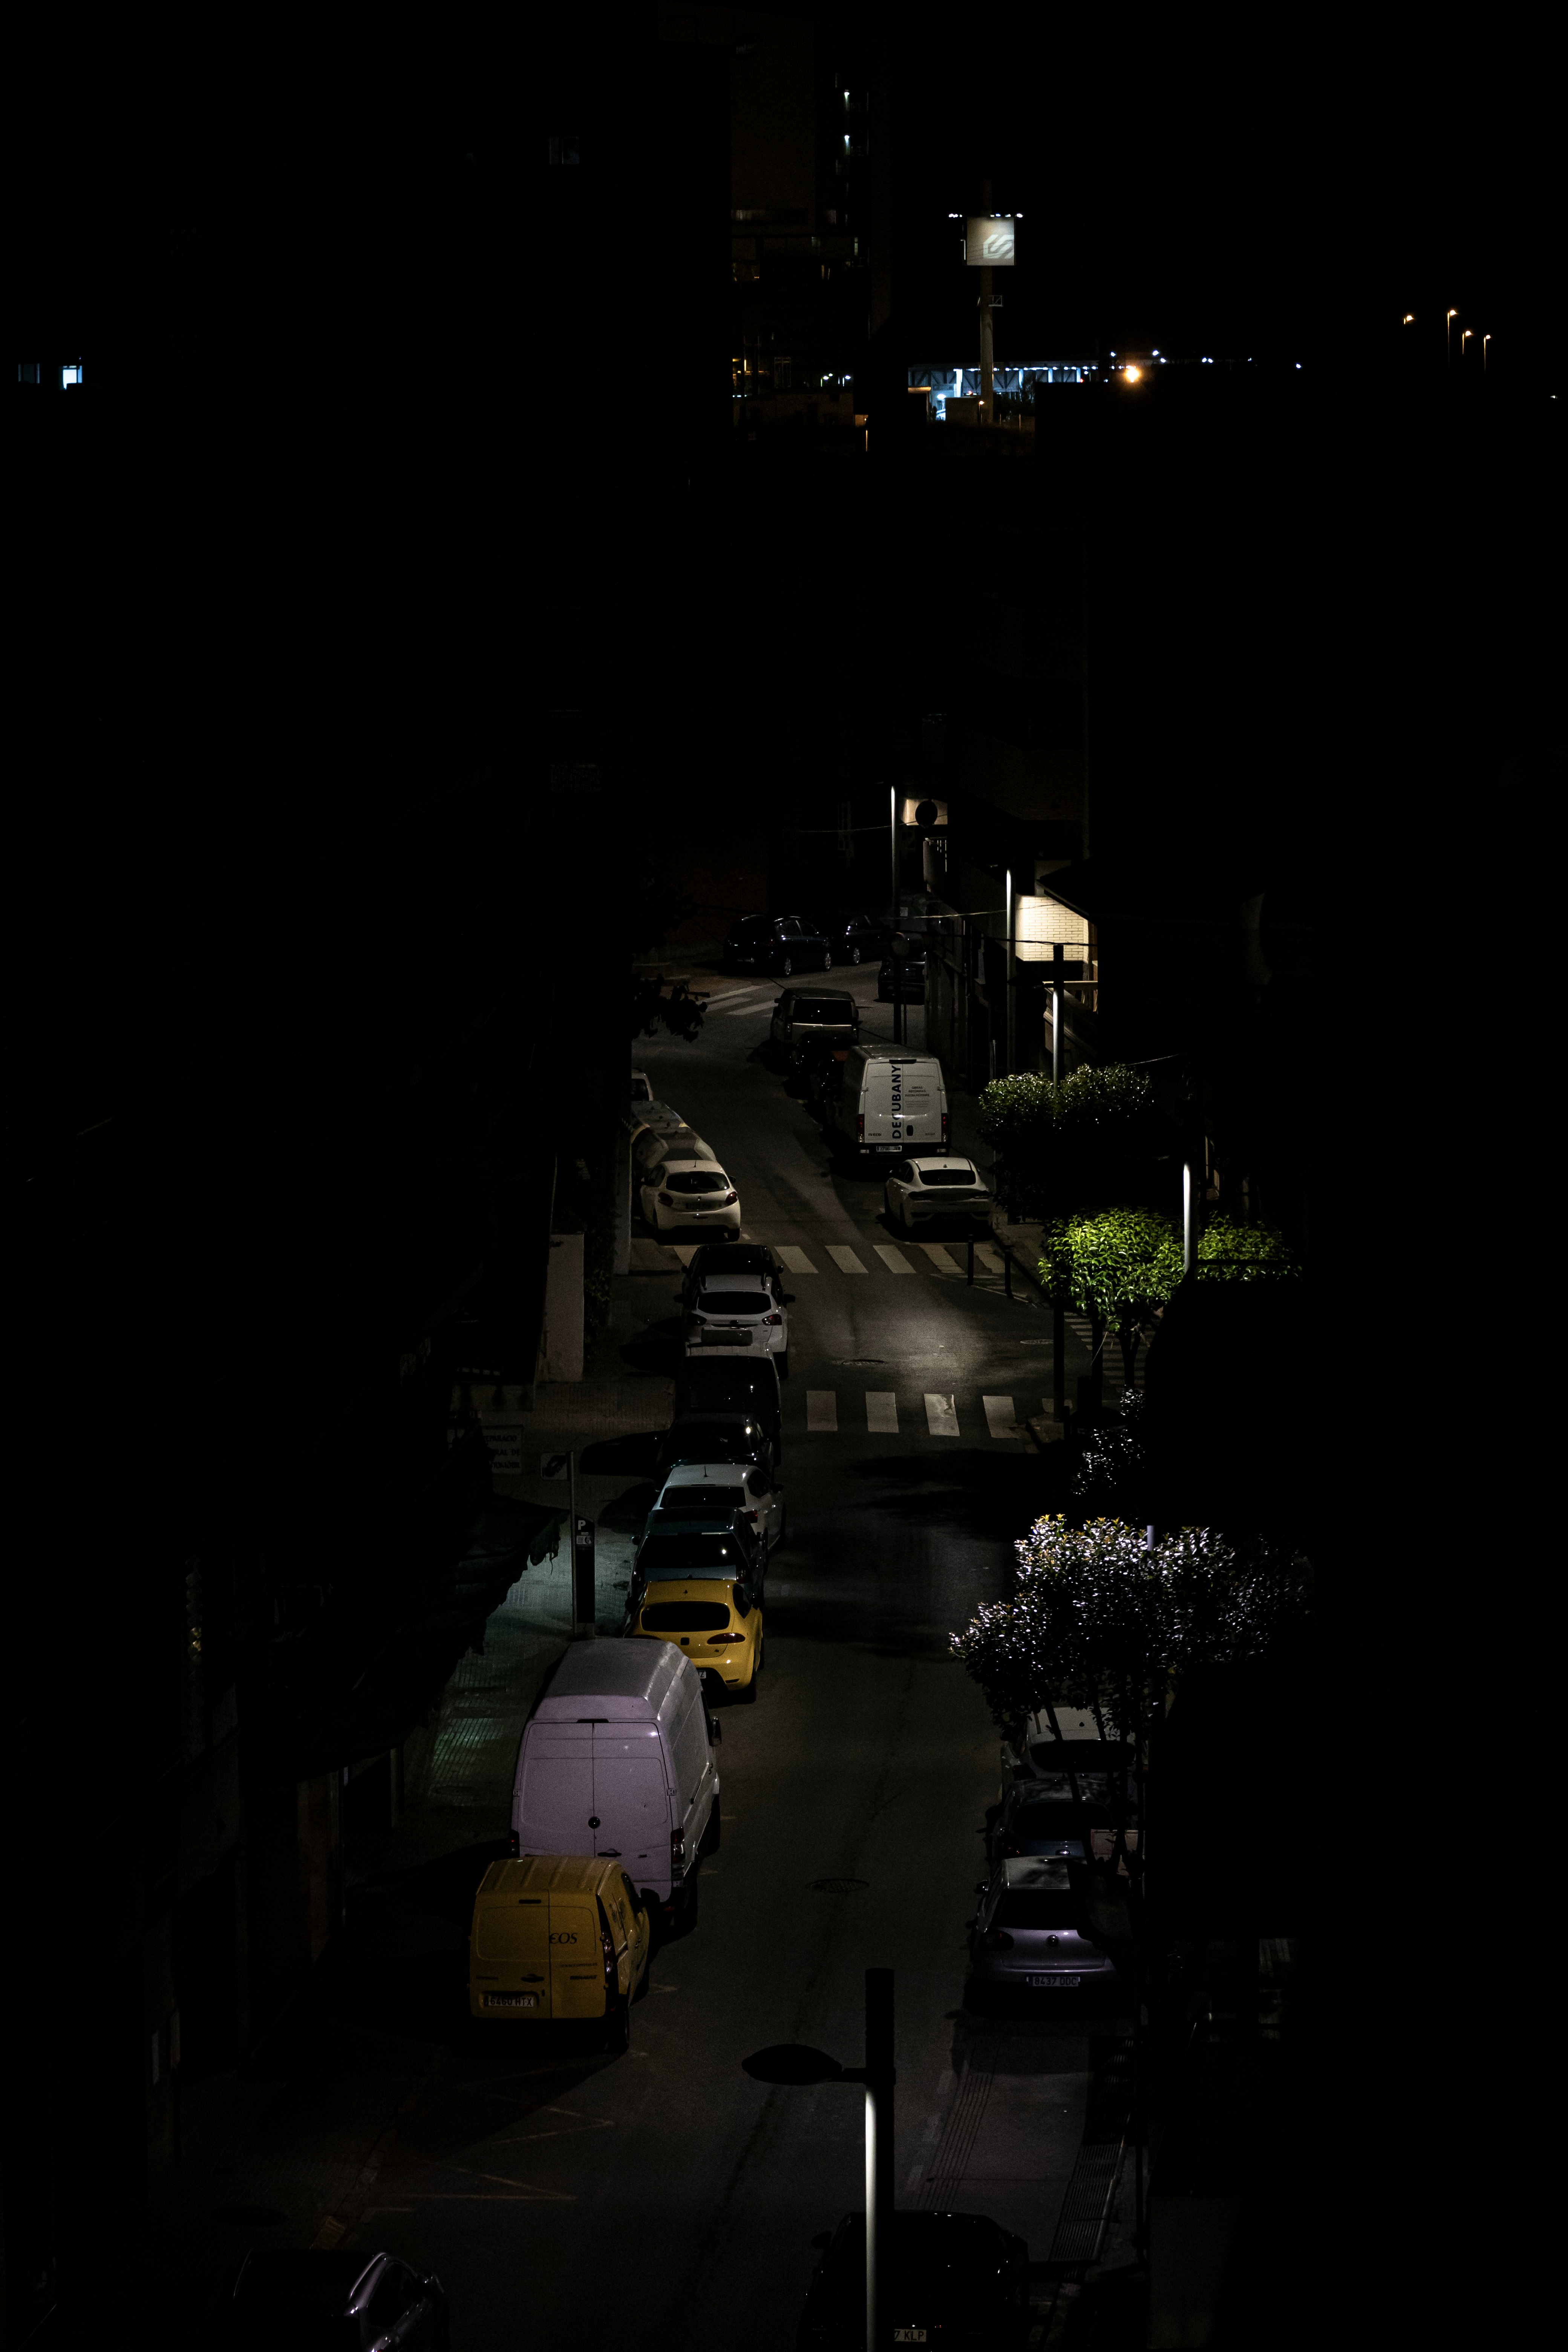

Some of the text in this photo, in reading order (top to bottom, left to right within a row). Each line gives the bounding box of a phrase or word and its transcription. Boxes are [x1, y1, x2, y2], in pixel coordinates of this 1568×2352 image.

[578, 1520, 586, 1530] P
[1035, 1977, 1076, 1986] 8437 DDC
[490, 1997, 532, 2006] 6460 HTX
[904, 2330, 924, 2340] KLP
